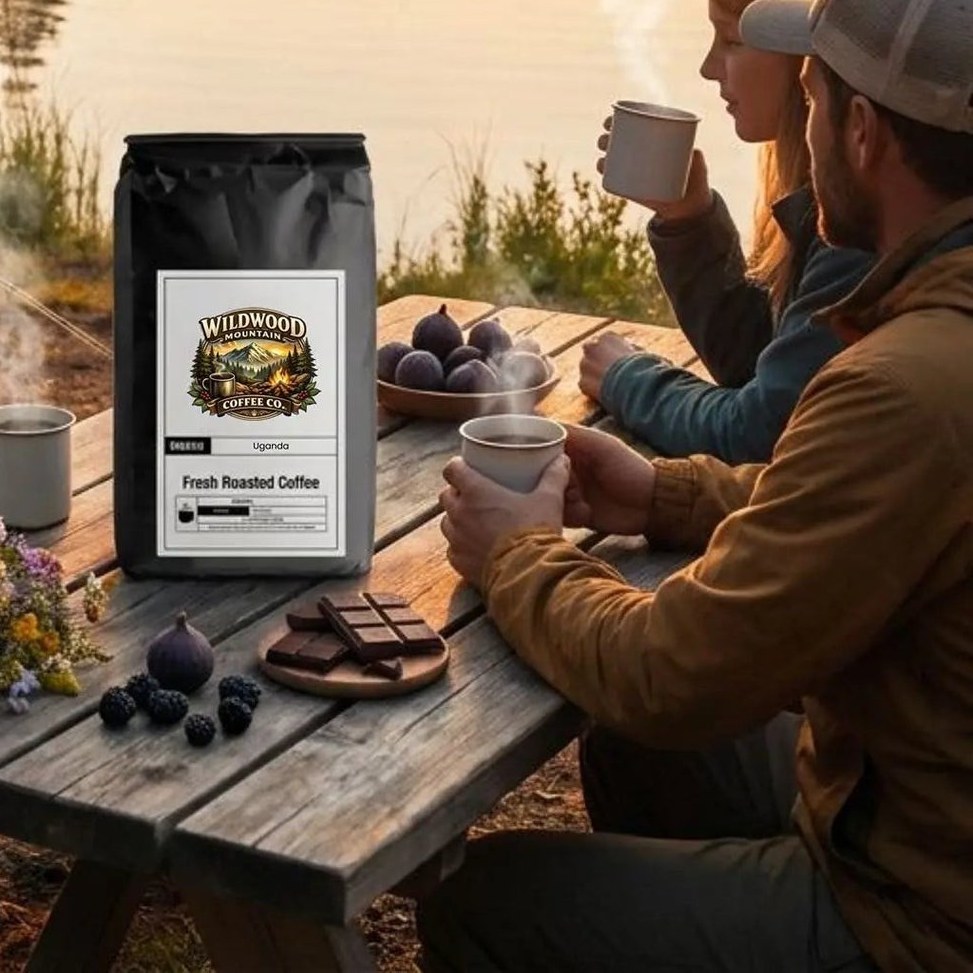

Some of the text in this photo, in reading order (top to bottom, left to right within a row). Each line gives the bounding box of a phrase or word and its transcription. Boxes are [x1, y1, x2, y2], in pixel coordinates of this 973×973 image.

[201, 312, 305, 339] WILDWOOD
[225, 331, 281, 340] MOUNTAIN
[223, 398, 285, 409] COFFEE CO.
[253, 442, 289, 452] Uganda
[183, 475, 320, 489] Fresh Roasted Coffee
